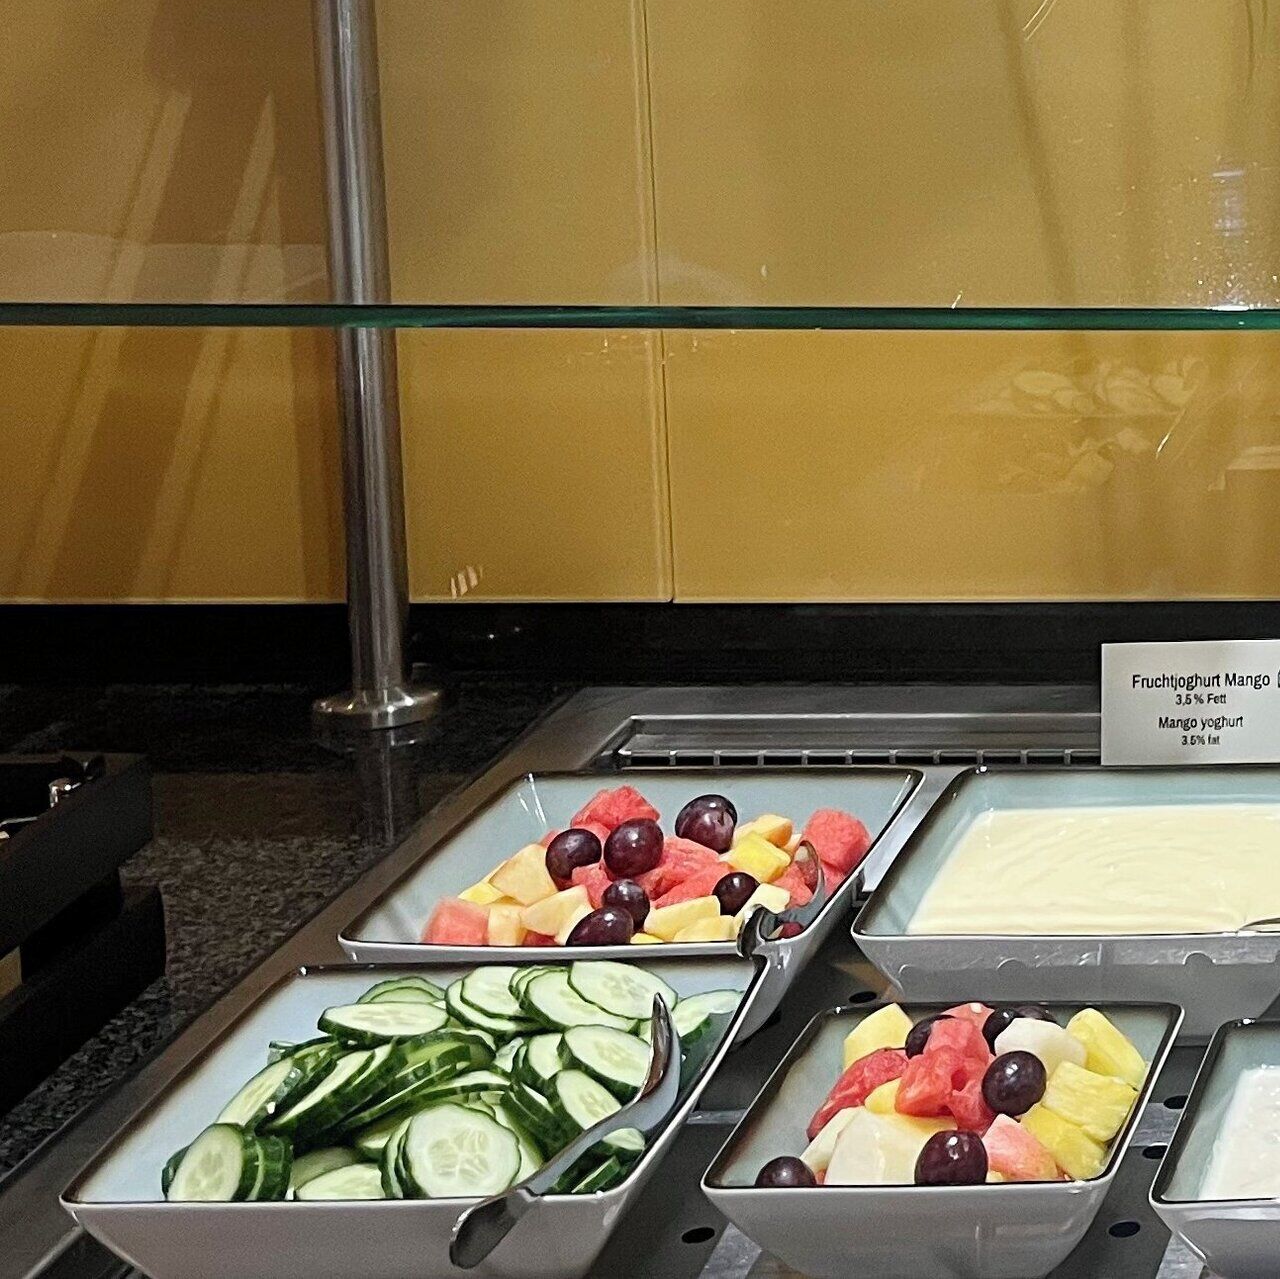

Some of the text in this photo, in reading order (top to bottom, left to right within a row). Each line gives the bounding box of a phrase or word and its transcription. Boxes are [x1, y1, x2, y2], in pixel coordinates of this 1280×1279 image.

[1132, 673, 1271, 691] Fruchtjoghurt Mango
[1207, 693, 1227, 704] Fett
[1158, 716, 1243, 731] Mango yoghurt
[1207, 735, 1220, 745] fat
